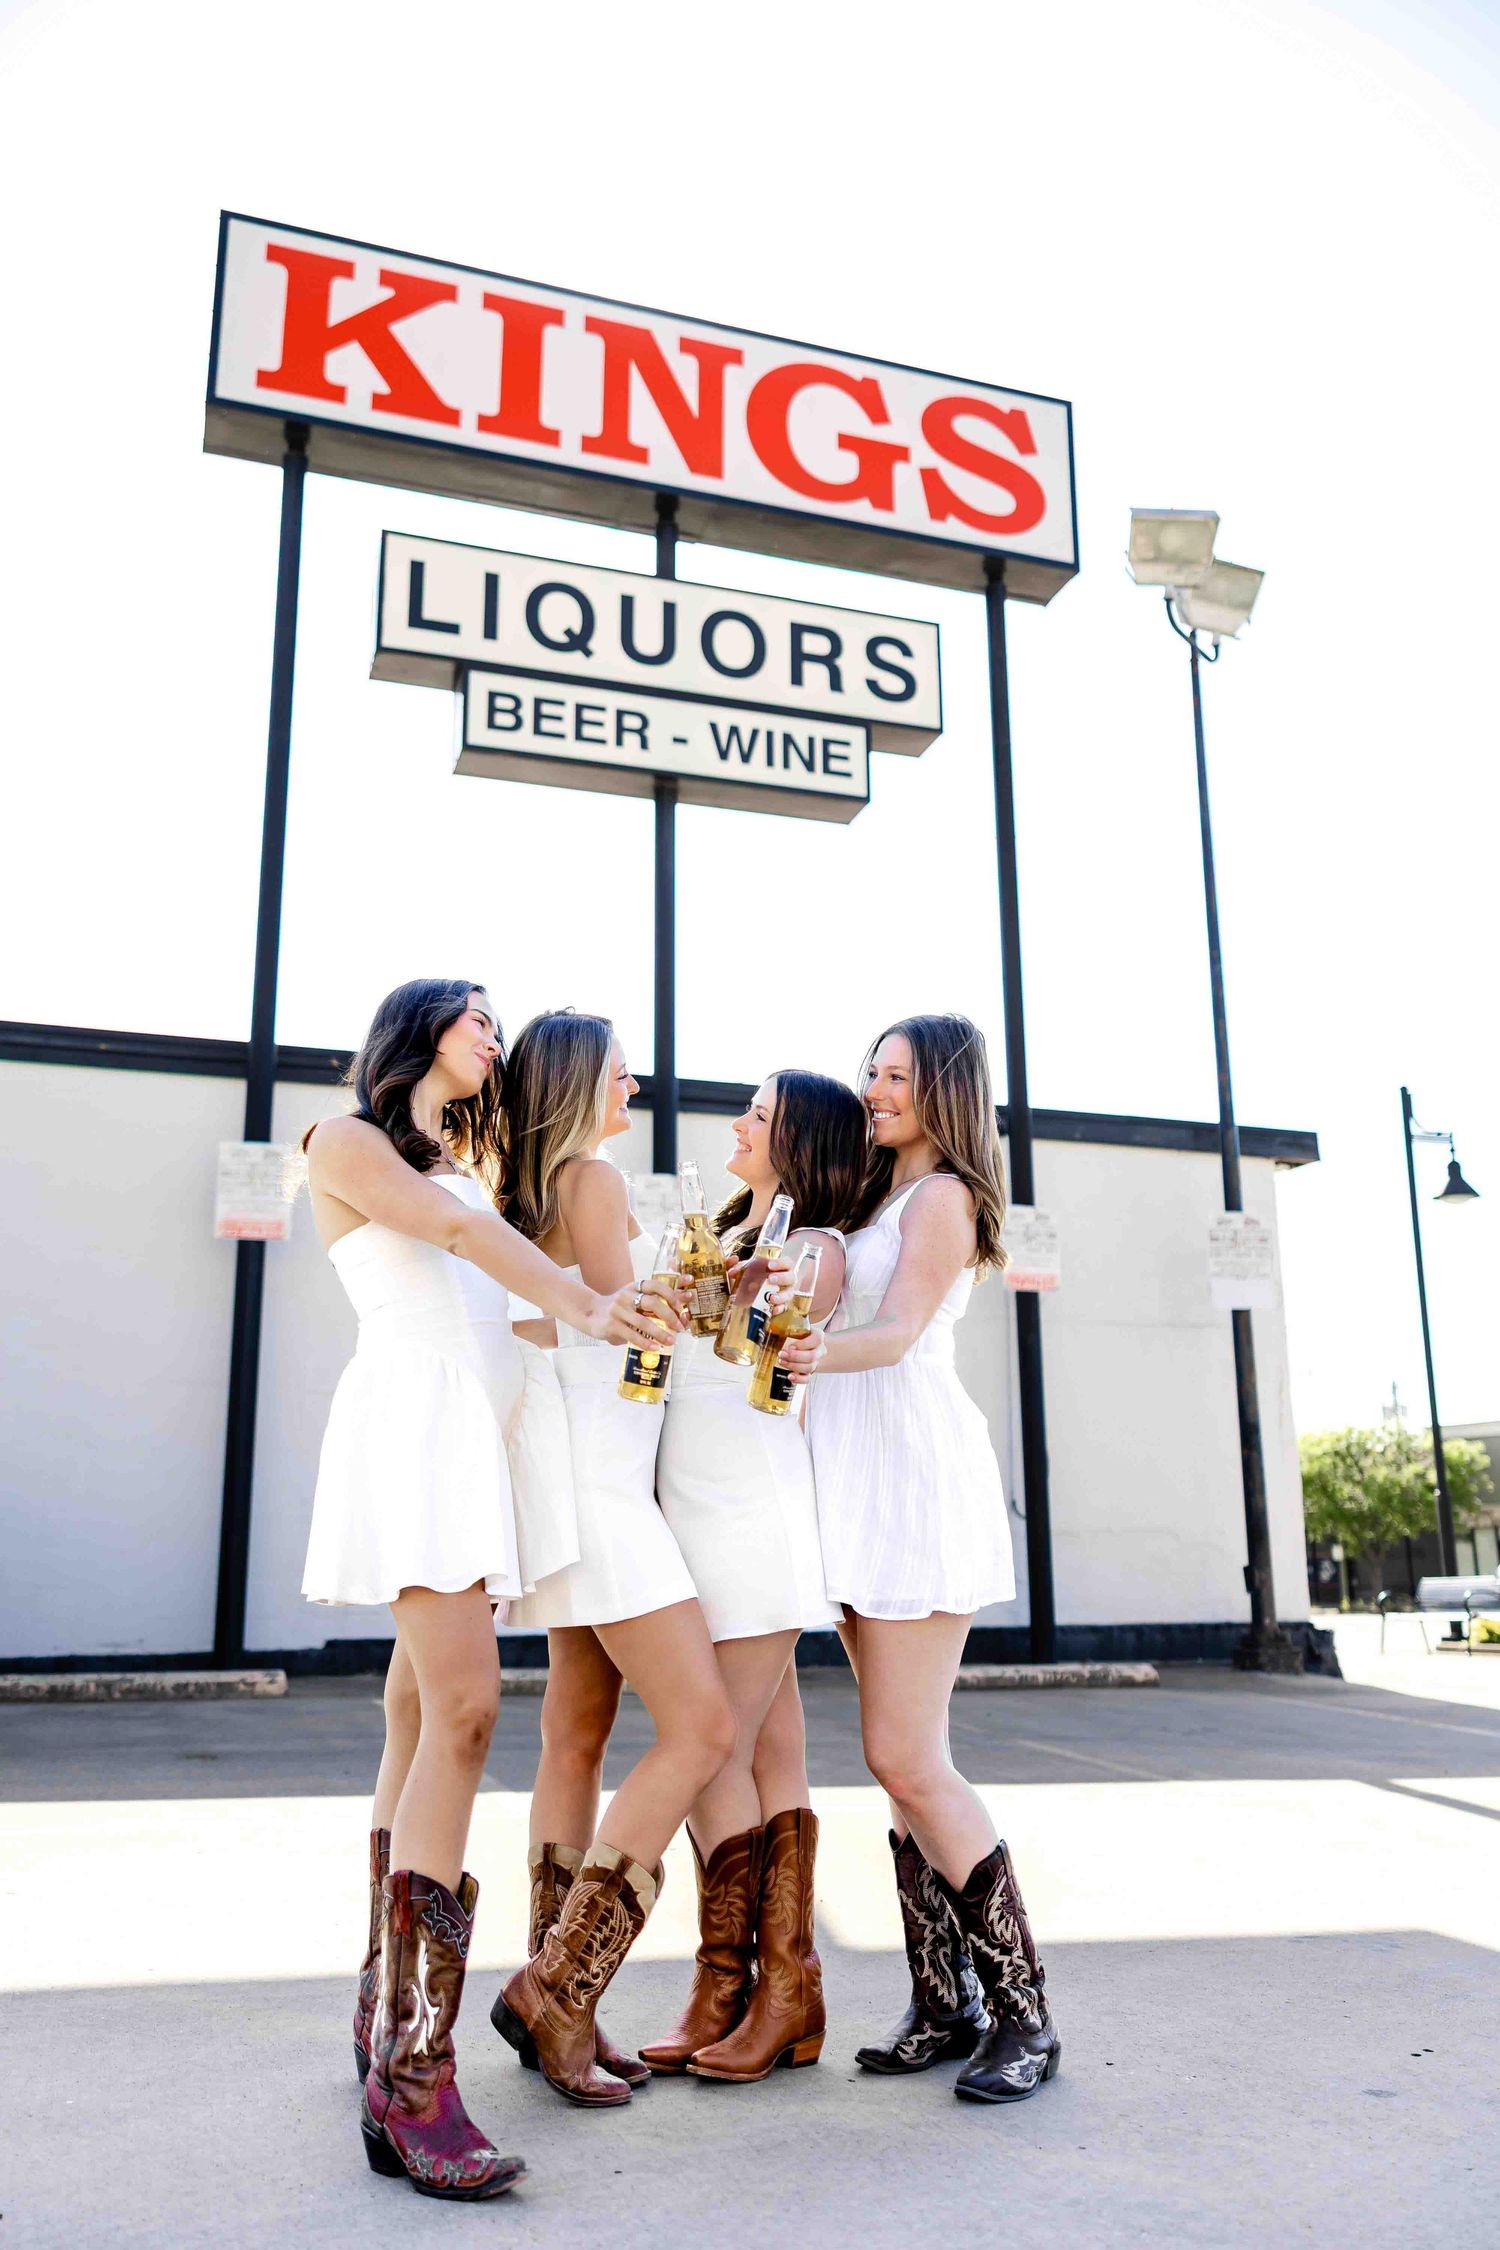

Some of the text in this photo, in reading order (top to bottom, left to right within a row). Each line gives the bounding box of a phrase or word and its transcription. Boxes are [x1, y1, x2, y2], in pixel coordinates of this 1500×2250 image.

[256, 243, 1046, 535] KINGS
[407, 559, 918, 703] LIQUORS
[487, 690, 650, 751] BEER
[709, 721, 853, 778] WINE
